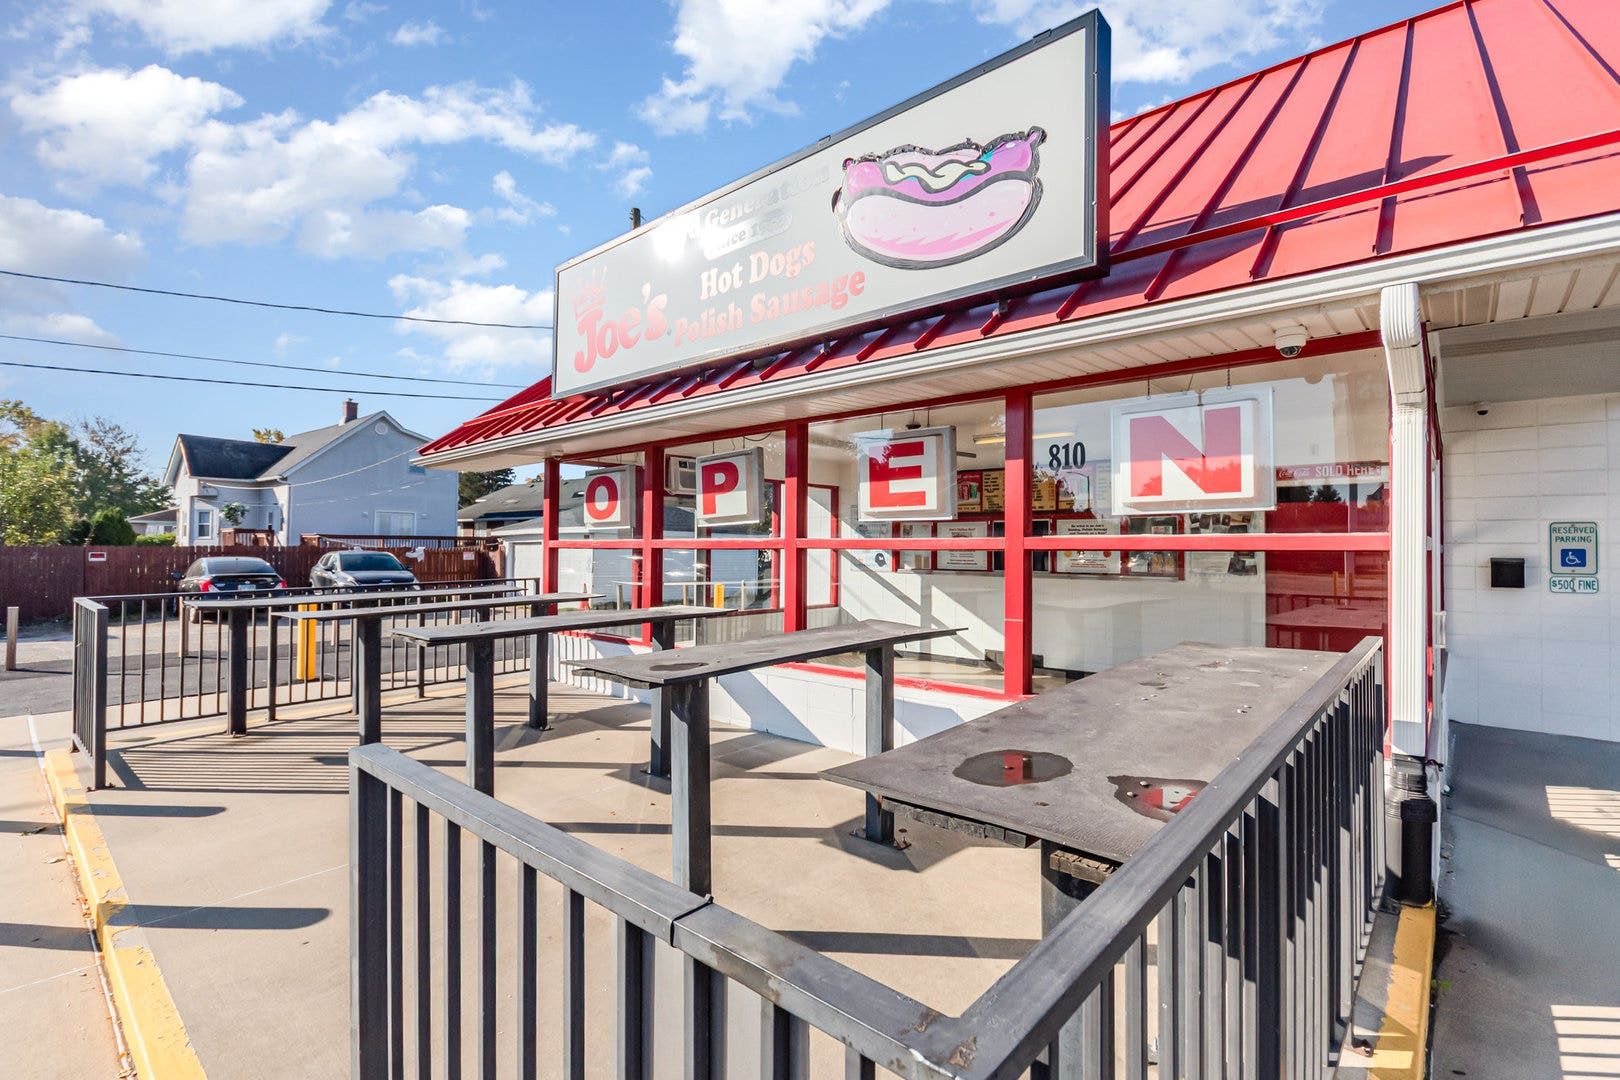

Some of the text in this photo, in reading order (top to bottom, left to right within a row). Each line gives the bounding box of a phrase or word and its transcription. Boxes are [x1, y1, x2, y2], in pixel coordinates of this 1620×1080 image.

[700, 241, 816, 300] Hot Dogs
[674, 271, 866, 347] Polish Sausage
[574, 281, 667, 374] Joe's
[1048, 441, 1086, 470] 810
[1315, 465, 1343, 478] SOLD
[1552, 526, 1595, 534] RESERVED
[1552, 579, 1597, 590] $500 FINE
